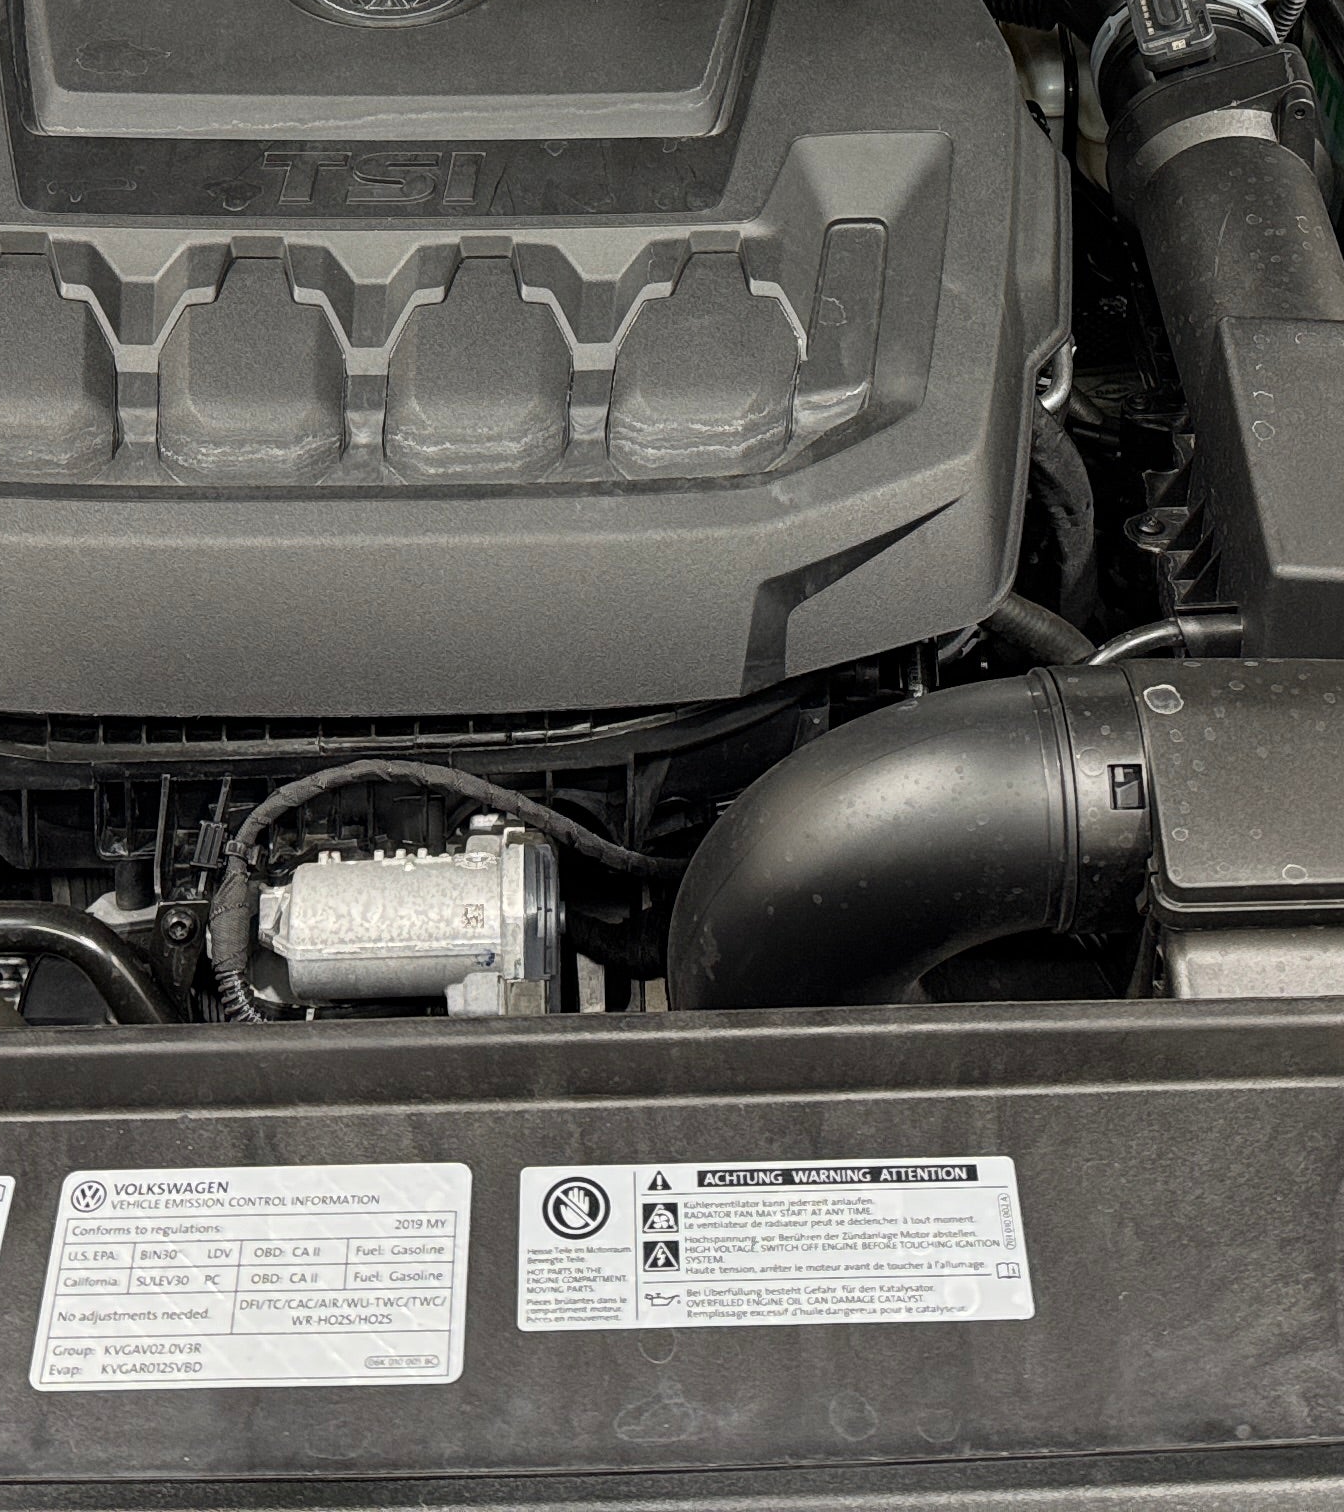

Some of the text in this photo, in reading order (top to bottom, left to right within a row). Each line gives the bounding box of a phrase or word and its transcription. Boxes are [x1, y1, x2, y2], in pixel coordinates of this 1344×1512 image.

[261, 151, 487, 206] TSI
[703, 1166, 968, 1186] ACHTUNG WARNING ATTENTION
[113, 1181, 230, 1196] VOLKSWAGEN
[110, 1194, 381, 1211] VEHICLE EMISSION CONTROL INFORMATION
[683, 1210, 732, 1220] RADIATOR
[733, 1210, 754, 1219] FAN
[755, 1209, 778, 1218] MAY
[779, 1208, 808, 1218] START
[810, 1208, 823, 1217] AT
[824, 1207, 845, 1216] ANY
[71, 1224, 132, 1237] Conforms
[134, 1225, 149, 1236] to
[394, 1218, 448, 1230] 2019 MY
[291, 1246, 310, 1258] CA
[312, 1246, 321, 1257] II
[390, 1243, 445, 1256] Gasoline
[684, 1245, 711, 1254] HIGH
[760, 1243, 799, 1253] SWITCH
[800, 1242, 819, 1252] OFF
[821, 1241, 859, 1252] ENGINE
[861, 1240, 898, 1251] BEFORE
[899, 1239, 954, 1250] TOUCHING
[954, 1238, 1001, 1249] IGNITION
[67, 1250, 90, 1262] U.S.
[139, 1249, 181, 1261] BIN30
[207, 1247, 233, 1260] LDV
[136, 1274, 190, 1287] SULEV30
[203, 1273, 221, 1286] PC
[288, 1272, 308, 1284] CA
[310, 1272, 319, 1284] II
[388, 1270, 444, 1282] Gasoline
[685, 1298, 745, 1309] OVERFILLED
[746, 1296, 784, 1307] ENGINE
[786, 1296, 803, 1306] OIL
[806, 1296, 829, 1306] CAN
[830, 1294, 876, 1305] DAMAGE
[56, 1311, 77, 1322] No
[77, 1310, 159, 1325] adjustments
